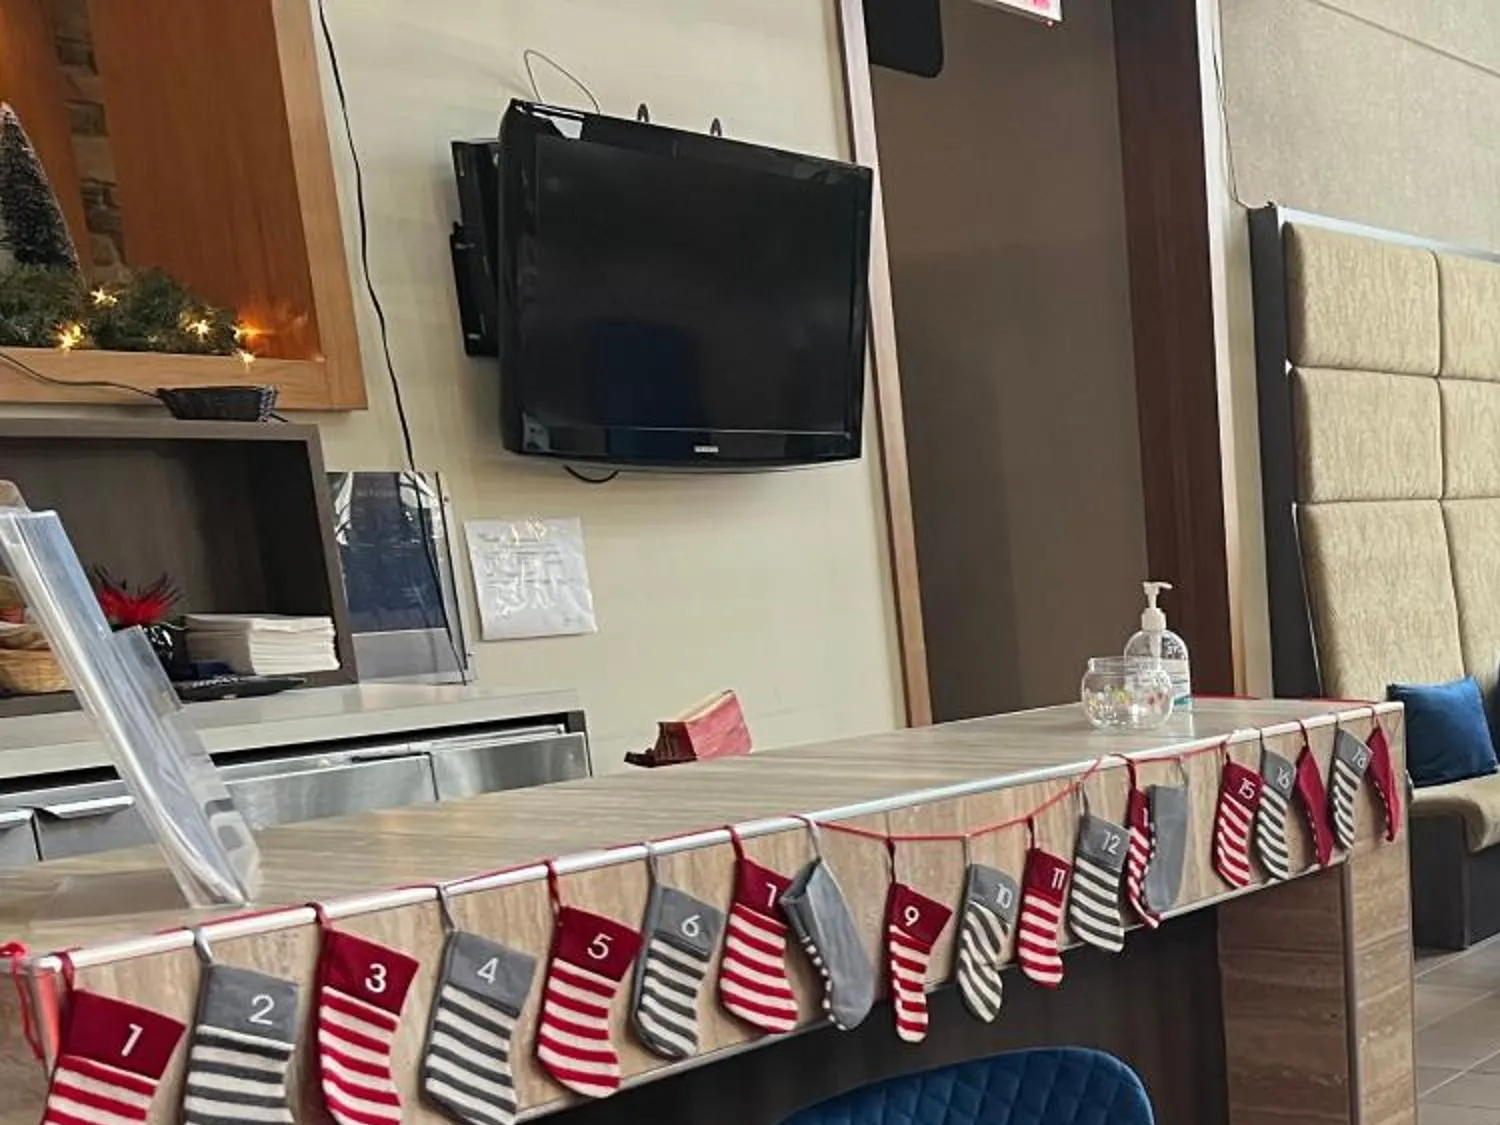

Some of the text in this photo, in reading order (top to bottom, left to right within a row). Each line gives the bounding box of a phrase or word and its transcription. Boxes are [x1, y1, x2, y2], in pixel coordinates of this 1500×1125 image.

[1239, 777, 1257, 799] 15
[1102, 828, 1120, 854] 12
[1051, 867, 1066, 889] 11
[995, 883, 1013, 909] 10
[682, 914, 700, 937] 6
[904, 907, 920, 926] 9
[587, 933, 612, 959] 5
[365, 963, 386, 993] 3
[476, 957, 498, 984] 4
[250, 994, 275, 1025] 2
[121, 1023, 142, 1056] 1
